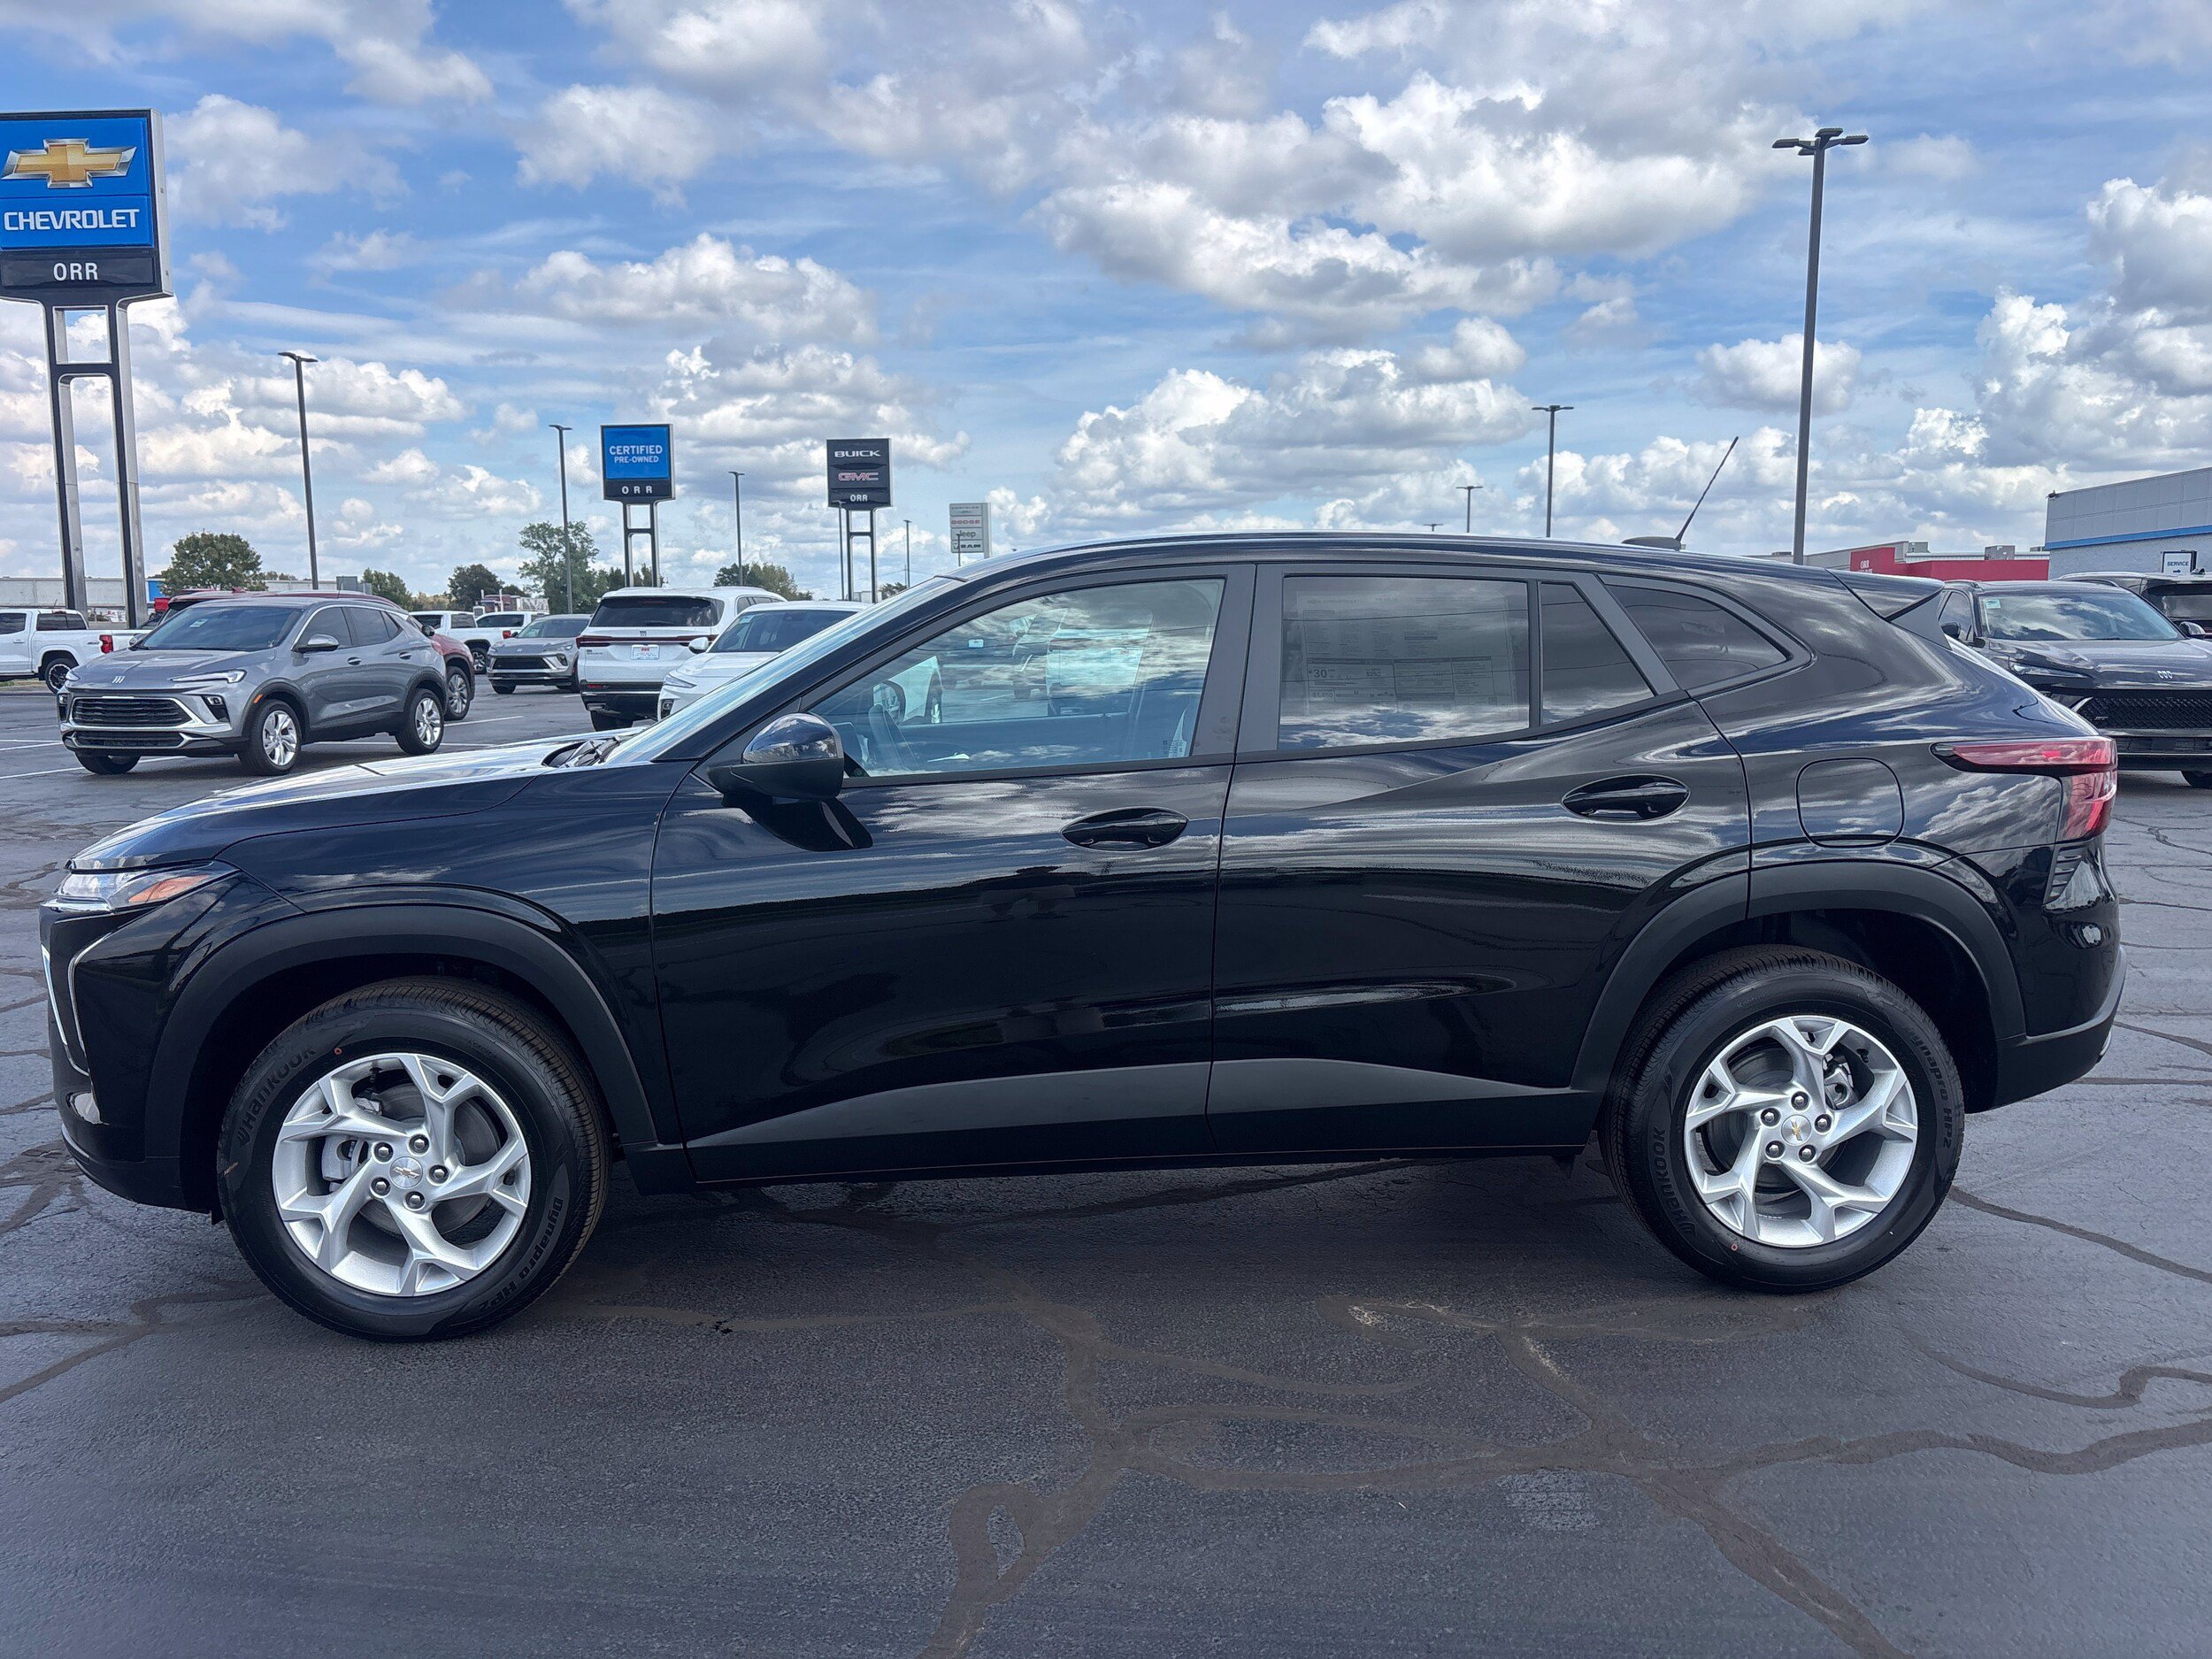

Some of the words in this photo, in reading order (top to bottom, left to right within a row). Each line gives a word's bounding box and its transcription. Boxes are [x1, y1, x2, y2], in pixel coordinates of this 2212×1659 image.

[4, 209, 140, 231] CHEVROLET
[53, 263, 98, 281] ORR
[609, 444, 663, 456] CERTIFIED
[838, 472, 879, 481] GMC
[1313, 669, 1328, 679] 30
[518, 1196, 565, 1280] Dynapro
